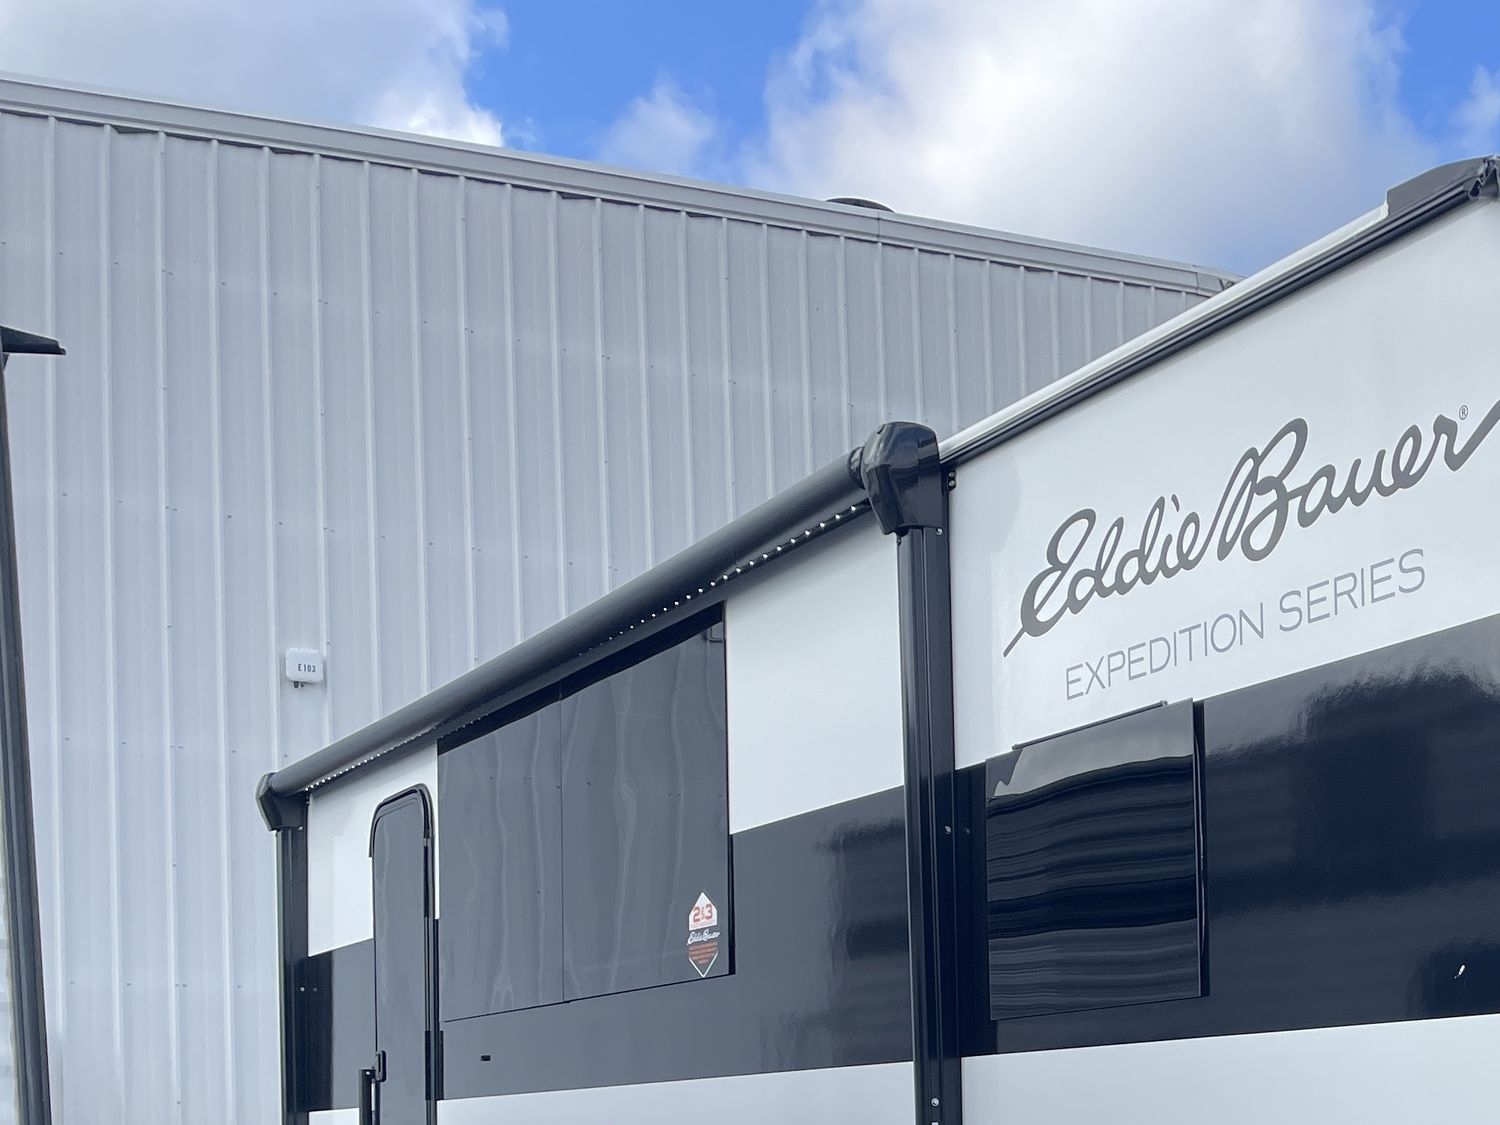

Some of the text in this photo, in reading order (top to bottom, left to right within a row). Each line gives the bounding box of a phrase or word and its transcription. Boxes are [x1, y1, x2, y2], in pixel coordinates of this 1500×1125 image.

[1001, 494, 1206, 658] Eddie
[1065, 548, 1428, 701] EXPEDITION SERIES
